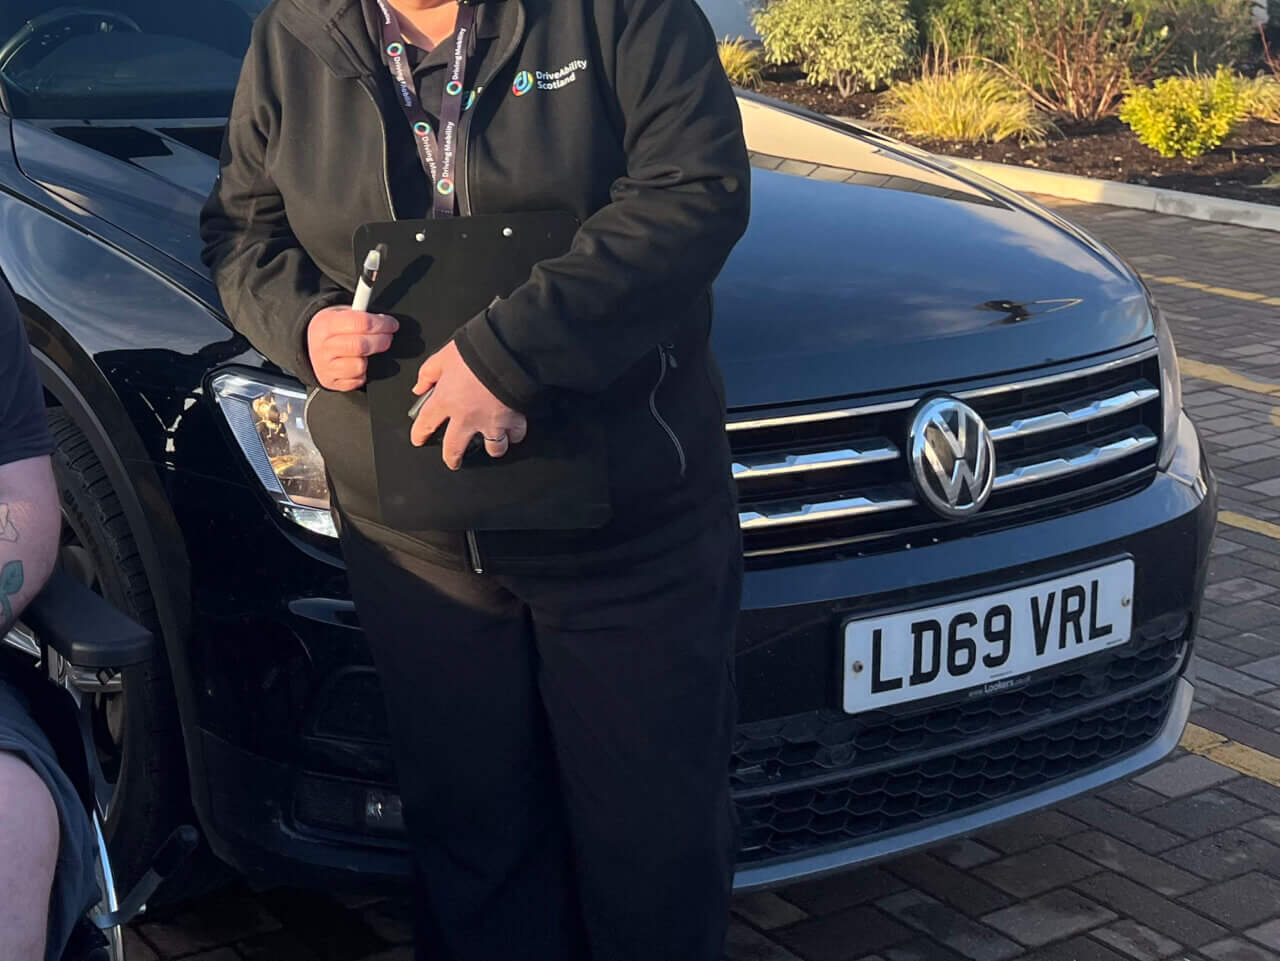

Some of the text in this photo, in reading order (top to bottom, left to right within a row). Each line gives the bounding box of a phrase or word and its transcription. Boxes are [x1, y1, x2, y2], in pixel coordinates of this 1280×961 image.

[536, 59, 587, 80] DriveAbility
[537, 72, 576, 90] Scotland
[870, 579, 1113, 695] LD69 VRL
